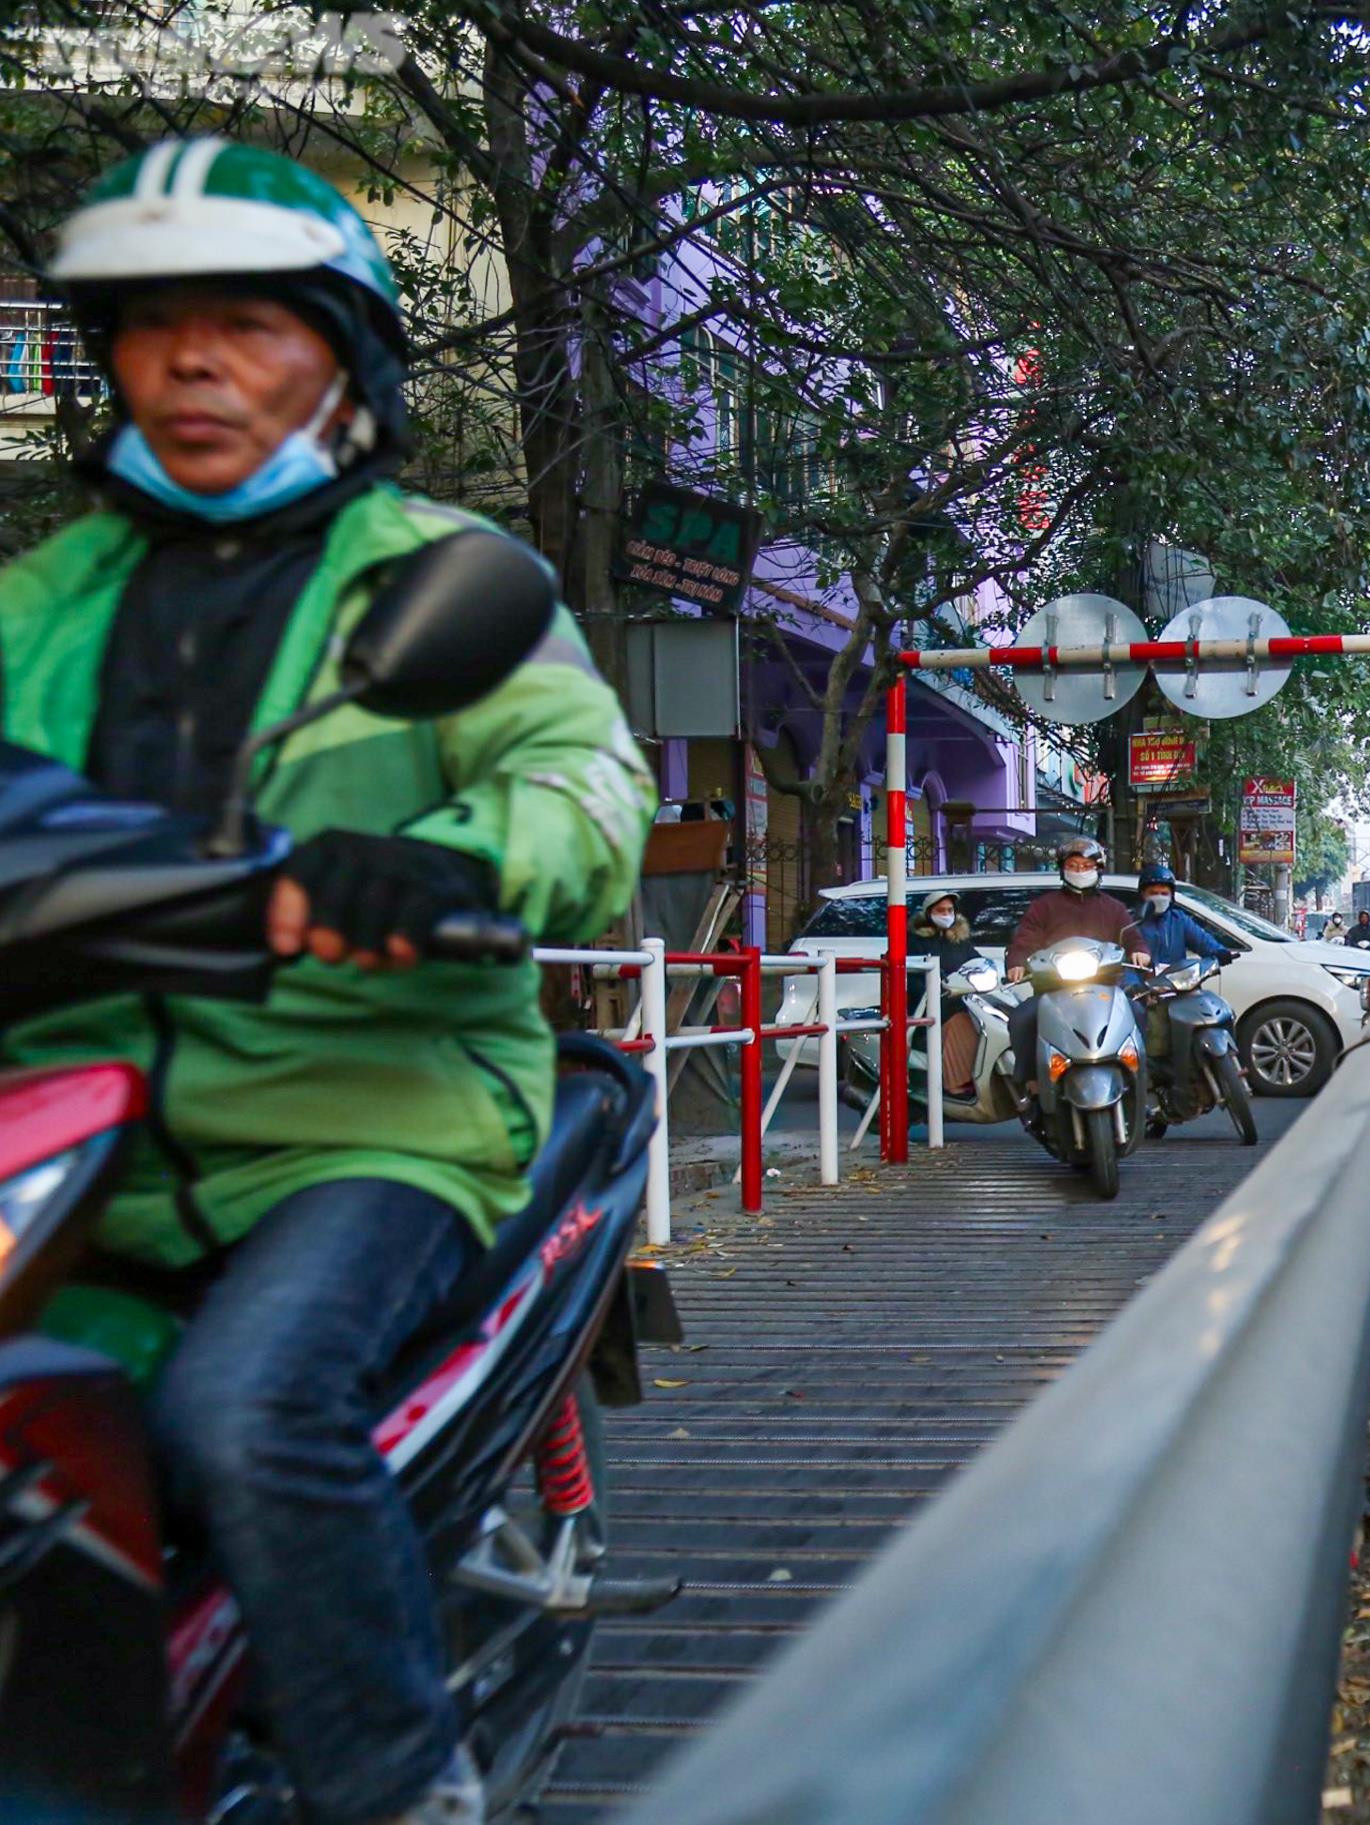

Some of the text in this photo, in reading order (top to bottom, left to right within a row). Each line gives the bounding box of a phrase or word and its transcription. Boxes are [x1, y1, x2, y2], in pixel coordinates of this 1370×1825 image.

[641, 503, 739, 562] SPA
[682, 558, 713, 578] TRIỆT
[711, 566, 740, 586] LÔNG
[1257, 795, 1293, 806] MASSAGE
